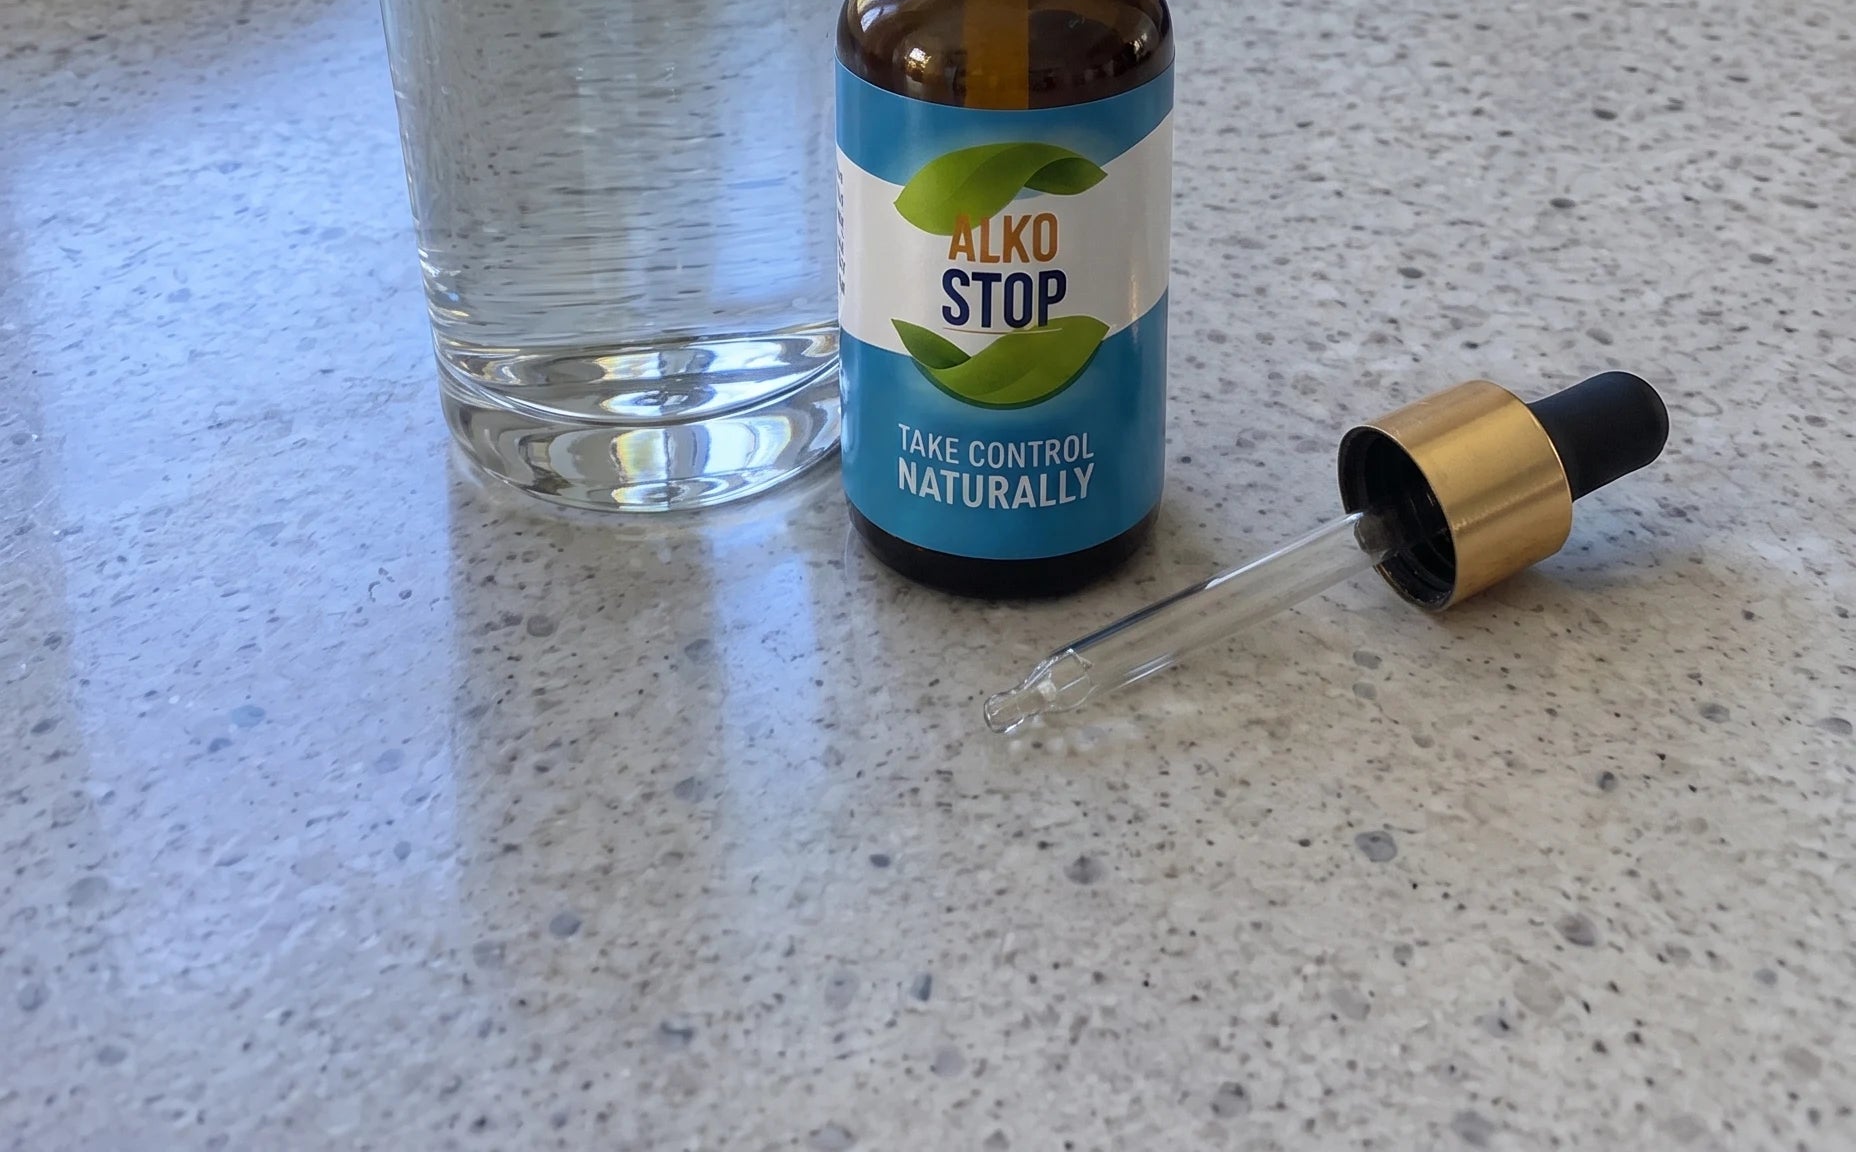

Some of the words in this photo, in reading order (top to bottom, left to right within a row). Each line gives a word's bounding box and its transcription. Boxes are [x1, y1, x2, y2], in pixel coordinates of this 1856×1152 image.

[948, 212, 1058, 264] ALKO
[942, 269, 1067, 329] STOP
[898, 423, 959, 464] TAKE
[968, 434, 1095, 469] CONTROL
[899, 457, 1096, 510] NATURALLY
